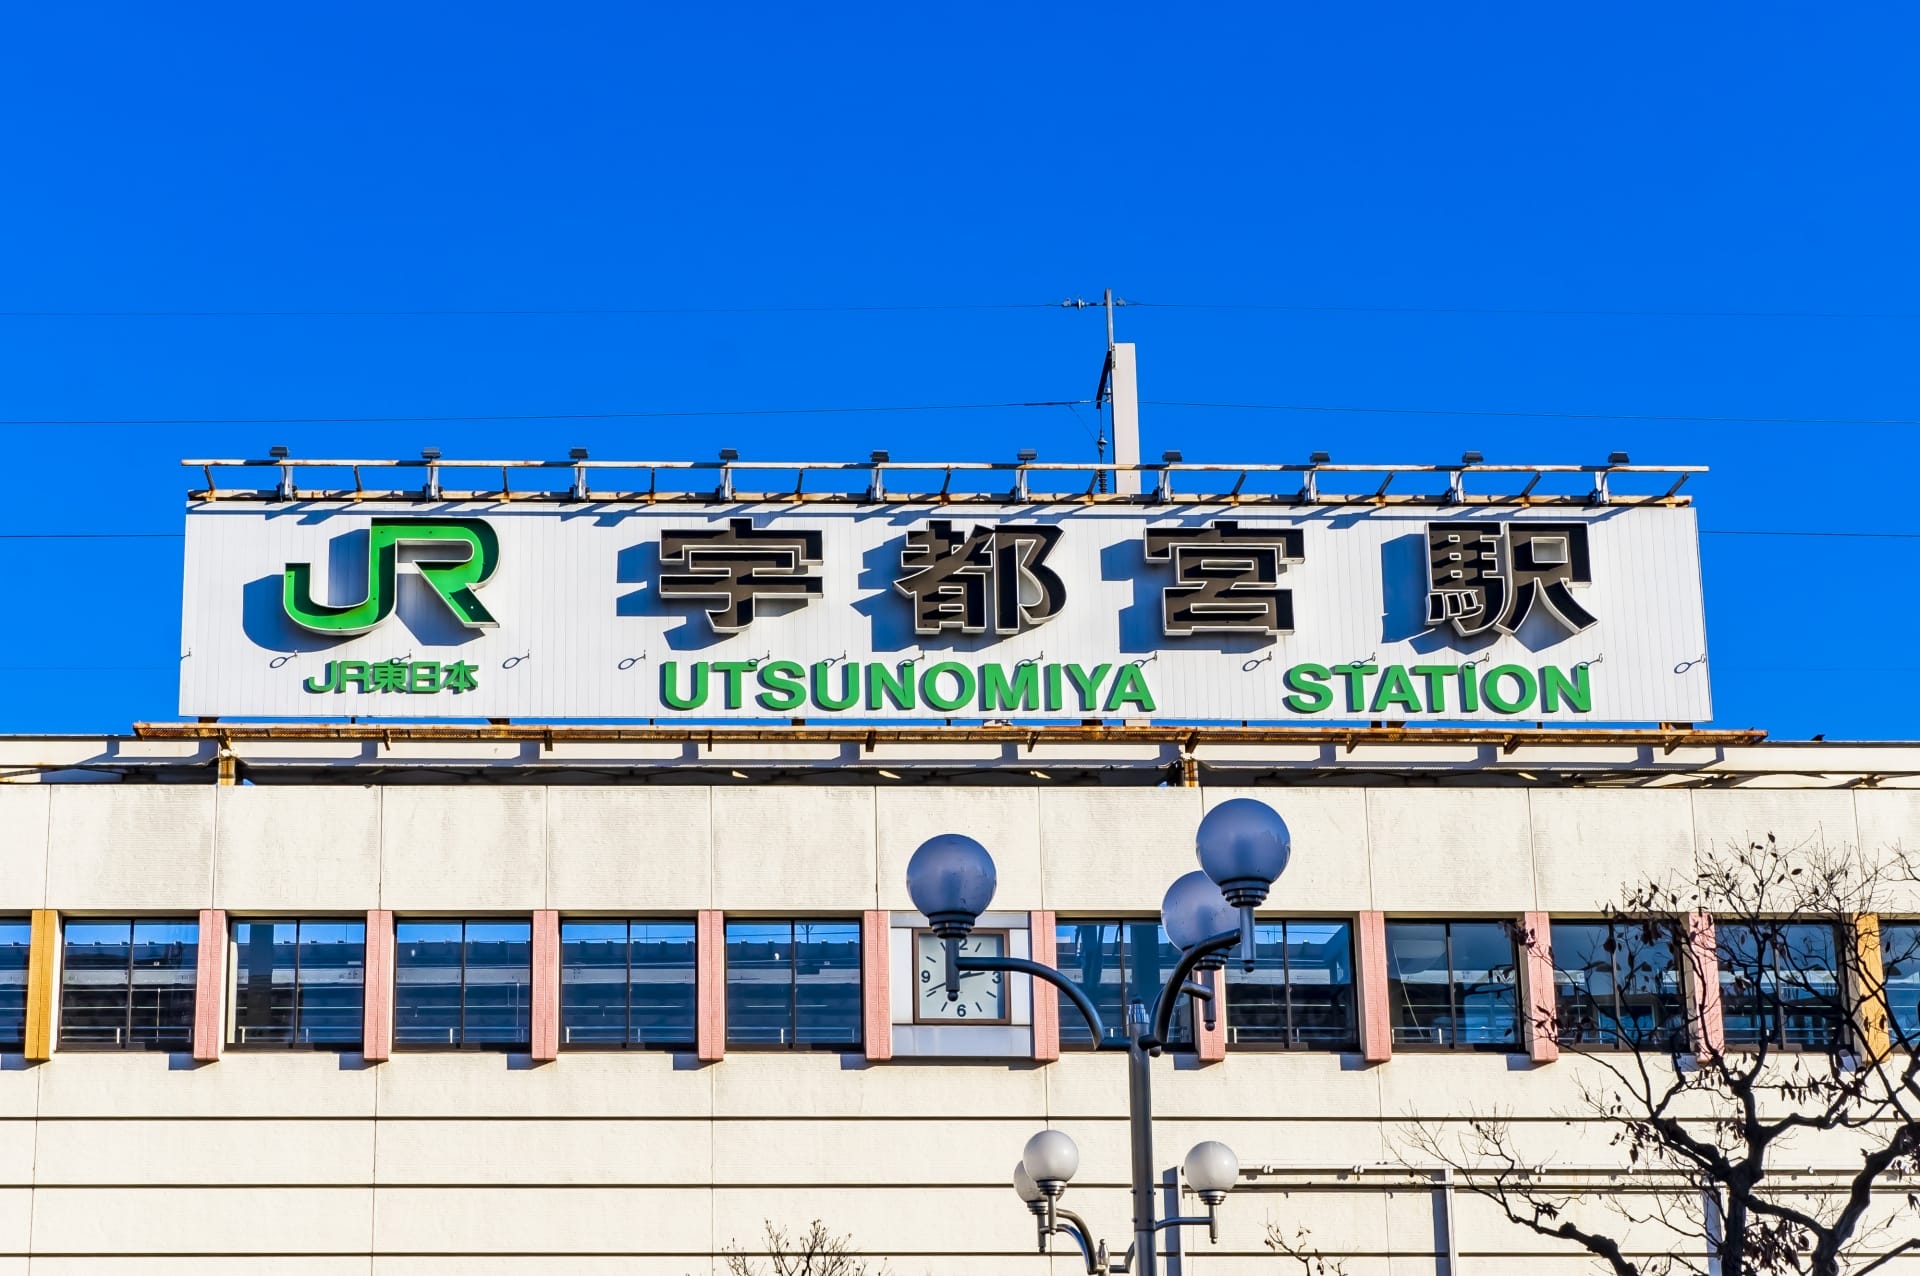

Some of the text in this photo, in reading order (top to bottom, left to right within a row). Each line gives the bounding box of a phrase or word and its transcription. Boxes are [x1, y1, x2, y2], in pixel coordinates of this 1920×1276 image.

[282, 516, 500, 636] JR
[307, 658, 480, 694] JR東日本
[661, 659, 1592, 713] UTSUNOMIYA STATION
[920, 970, 931, 983] 9
[956, 1004, 967, 1017] 6
